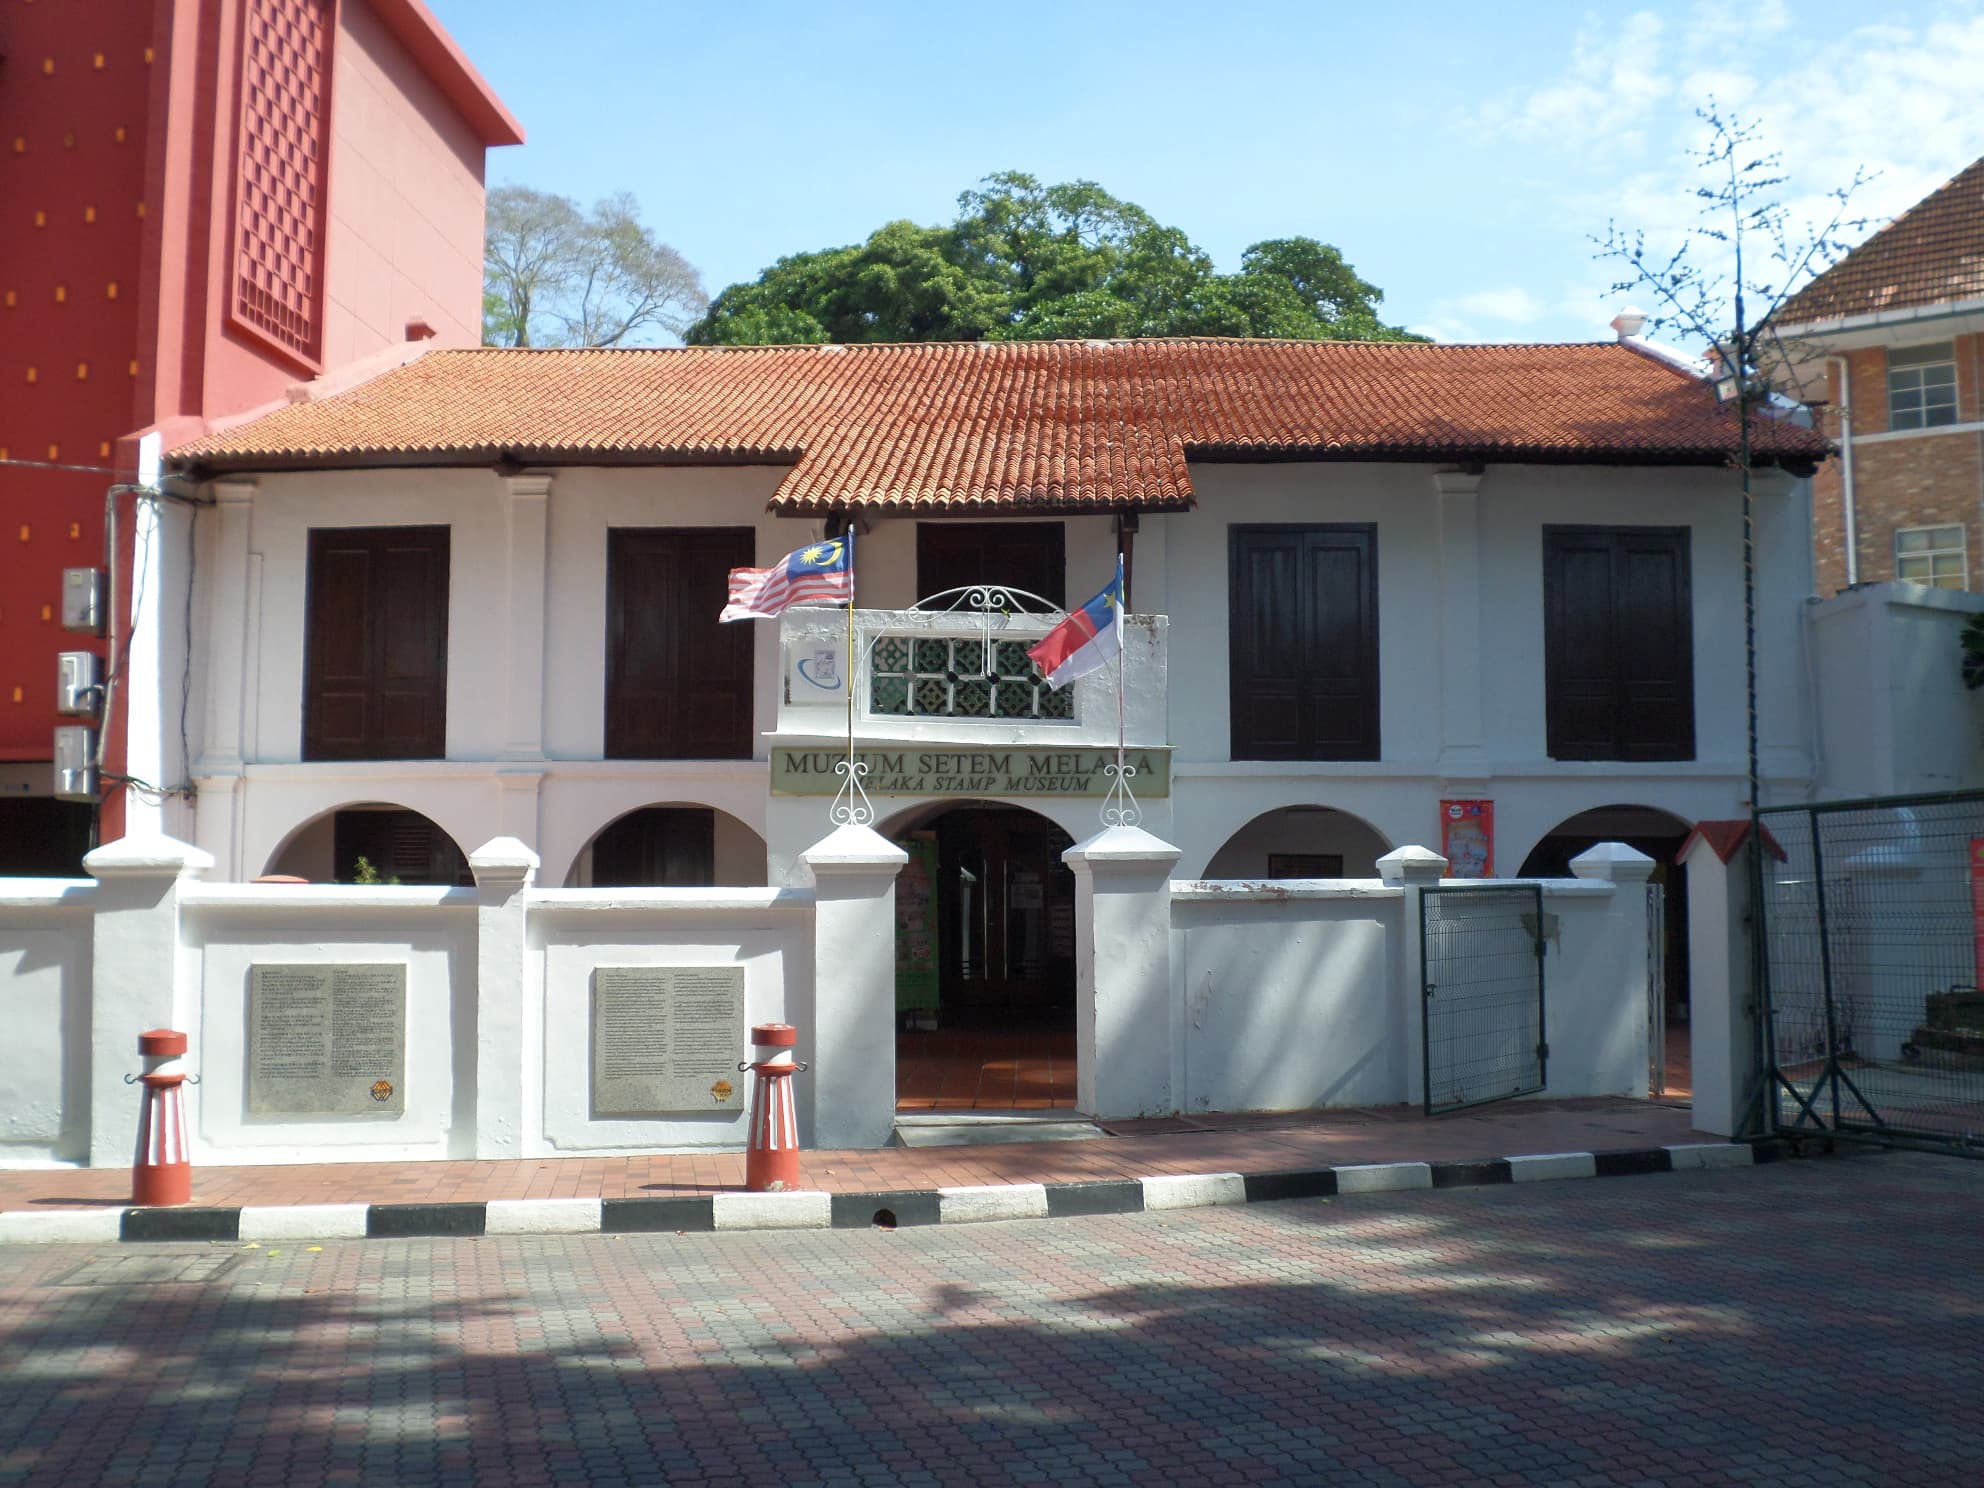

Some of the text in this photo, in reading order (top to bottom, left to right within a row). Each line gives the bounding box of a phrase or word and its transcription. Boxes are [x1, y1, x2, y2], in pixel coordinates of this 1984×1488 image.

[785, 753, 905, 774] MUZUM
[918, 754, 1012, 775] SETEM
[933, 776, 996, 791] STAMP
[1004, 776, 1091, 792] MUSEUM
